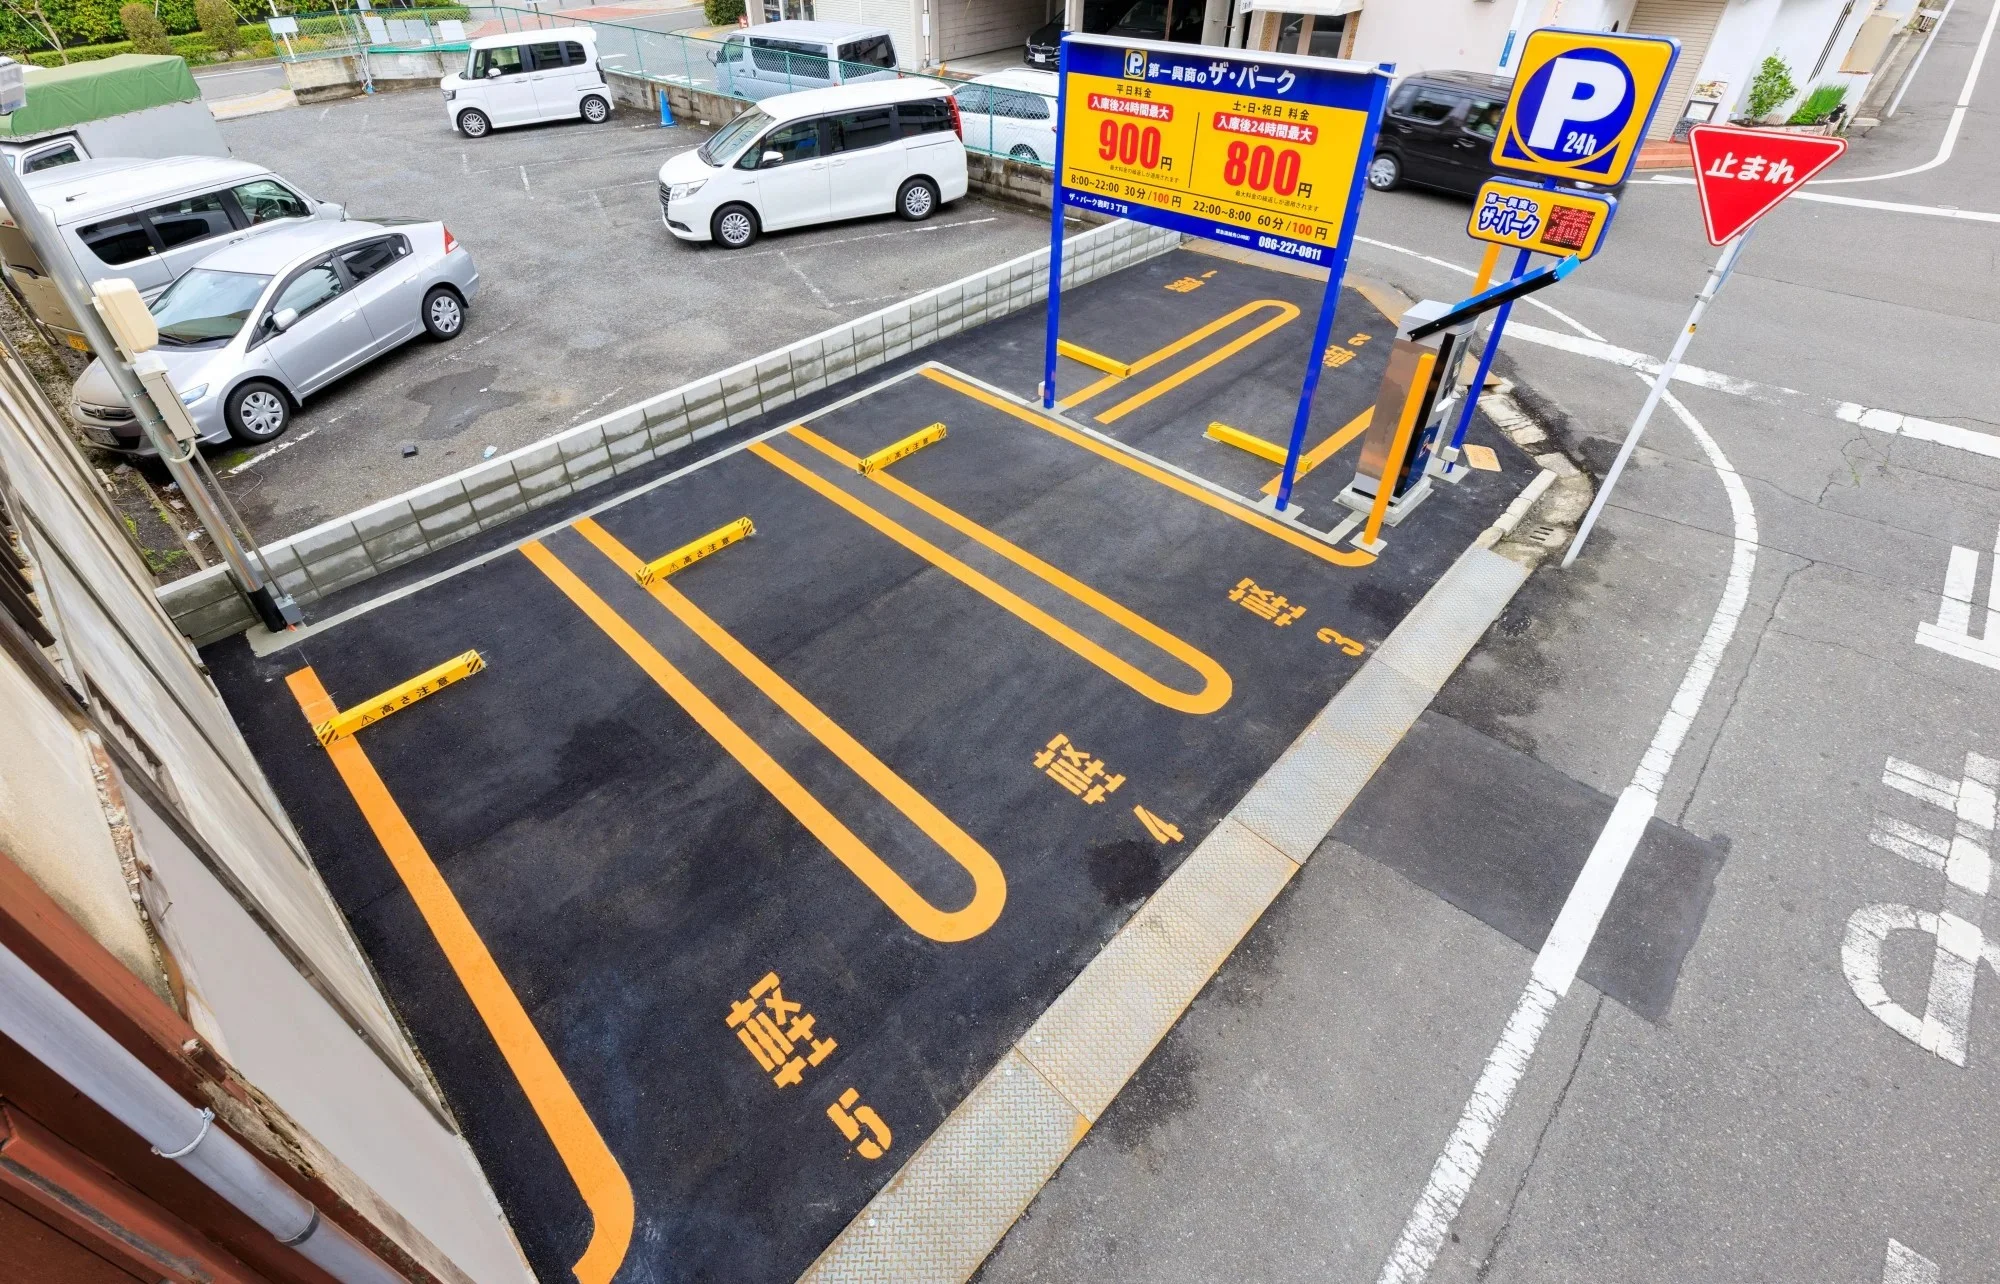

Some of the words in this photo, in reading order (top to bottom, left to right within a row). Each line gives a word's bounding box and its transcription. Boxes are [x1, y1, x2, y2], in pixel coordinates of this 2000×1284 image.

[1116, 84, 1152, 99] 平日料金
[1527, 57, 1627, 150] P
[1091, 95, 1170, 119] 入庫後24時間最大
[1232, 100, 1282, 117] 土・日・祝日
[1288, 107, 1310, 121] 料金
[1217, 115, 1313, 143] 入庫後24時間最大
[1562, 131, 1597, 156] 24h
[1705, 152, 1795, 184] 止まれ
[1486, 192, 1538, 213] 第一興商の
[1478, 206, 1540, 239] ザ・パーク
[1258, 235, 1323, 261] 086-227-0811
[683, 537, 730, 566] 高さ注意
[1228, 577, 1307, 627] 軽
[1316, 627, 1365, 656] 3
[380, 676, 450, 716] 高さ注意
[1033, 733, 1126, 805] 軽
[1133, 804, 1184, 844] 4
[725, 971, 838, 1089] 軽
[826, 1087, 892, 1160] 5
